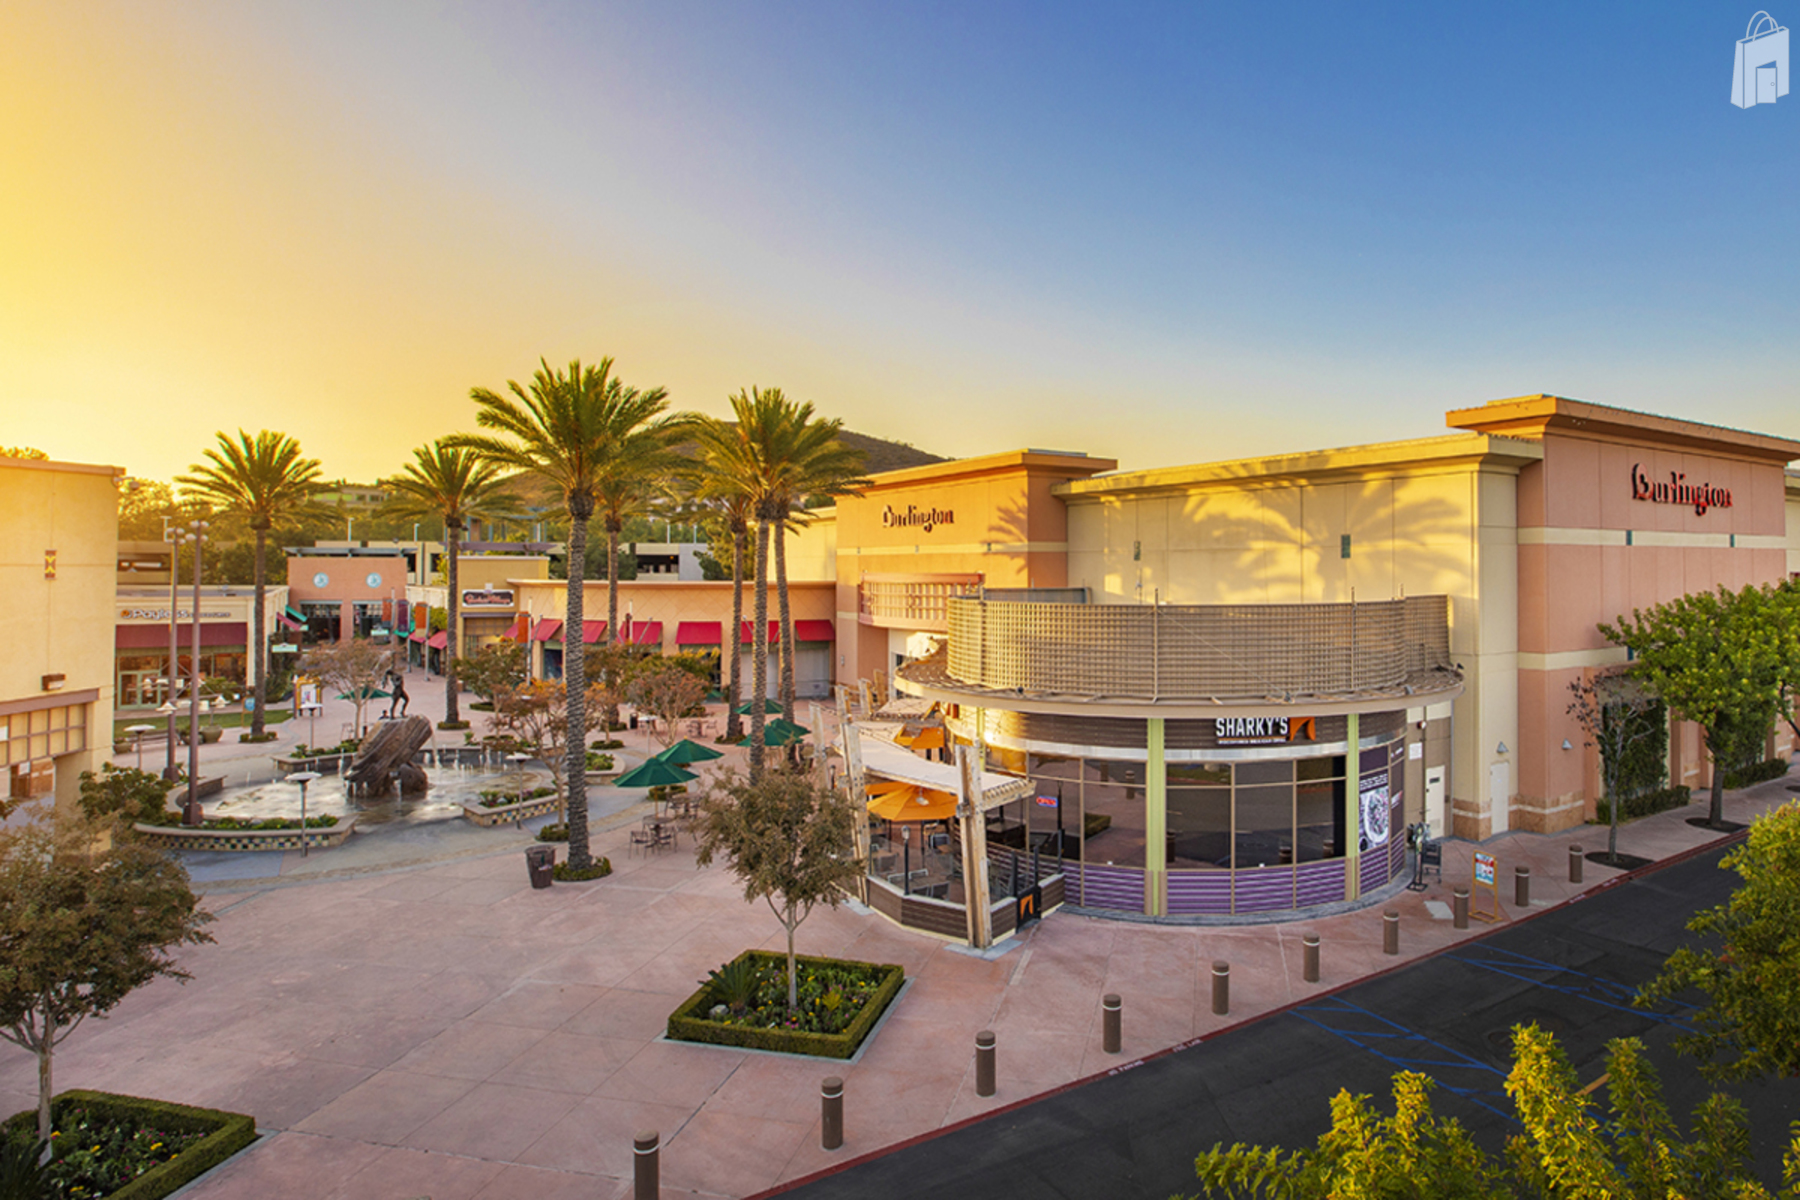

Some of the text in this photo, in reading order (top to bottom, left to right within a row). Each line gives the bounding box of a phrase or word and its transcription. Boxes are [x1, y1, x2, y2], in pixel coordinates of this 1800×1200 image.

[1631, 463, 1733, 517] Burlington
[882, 504, 954, 533] Burlington
[1215, 716, 1289, 737] SHARKY'S
